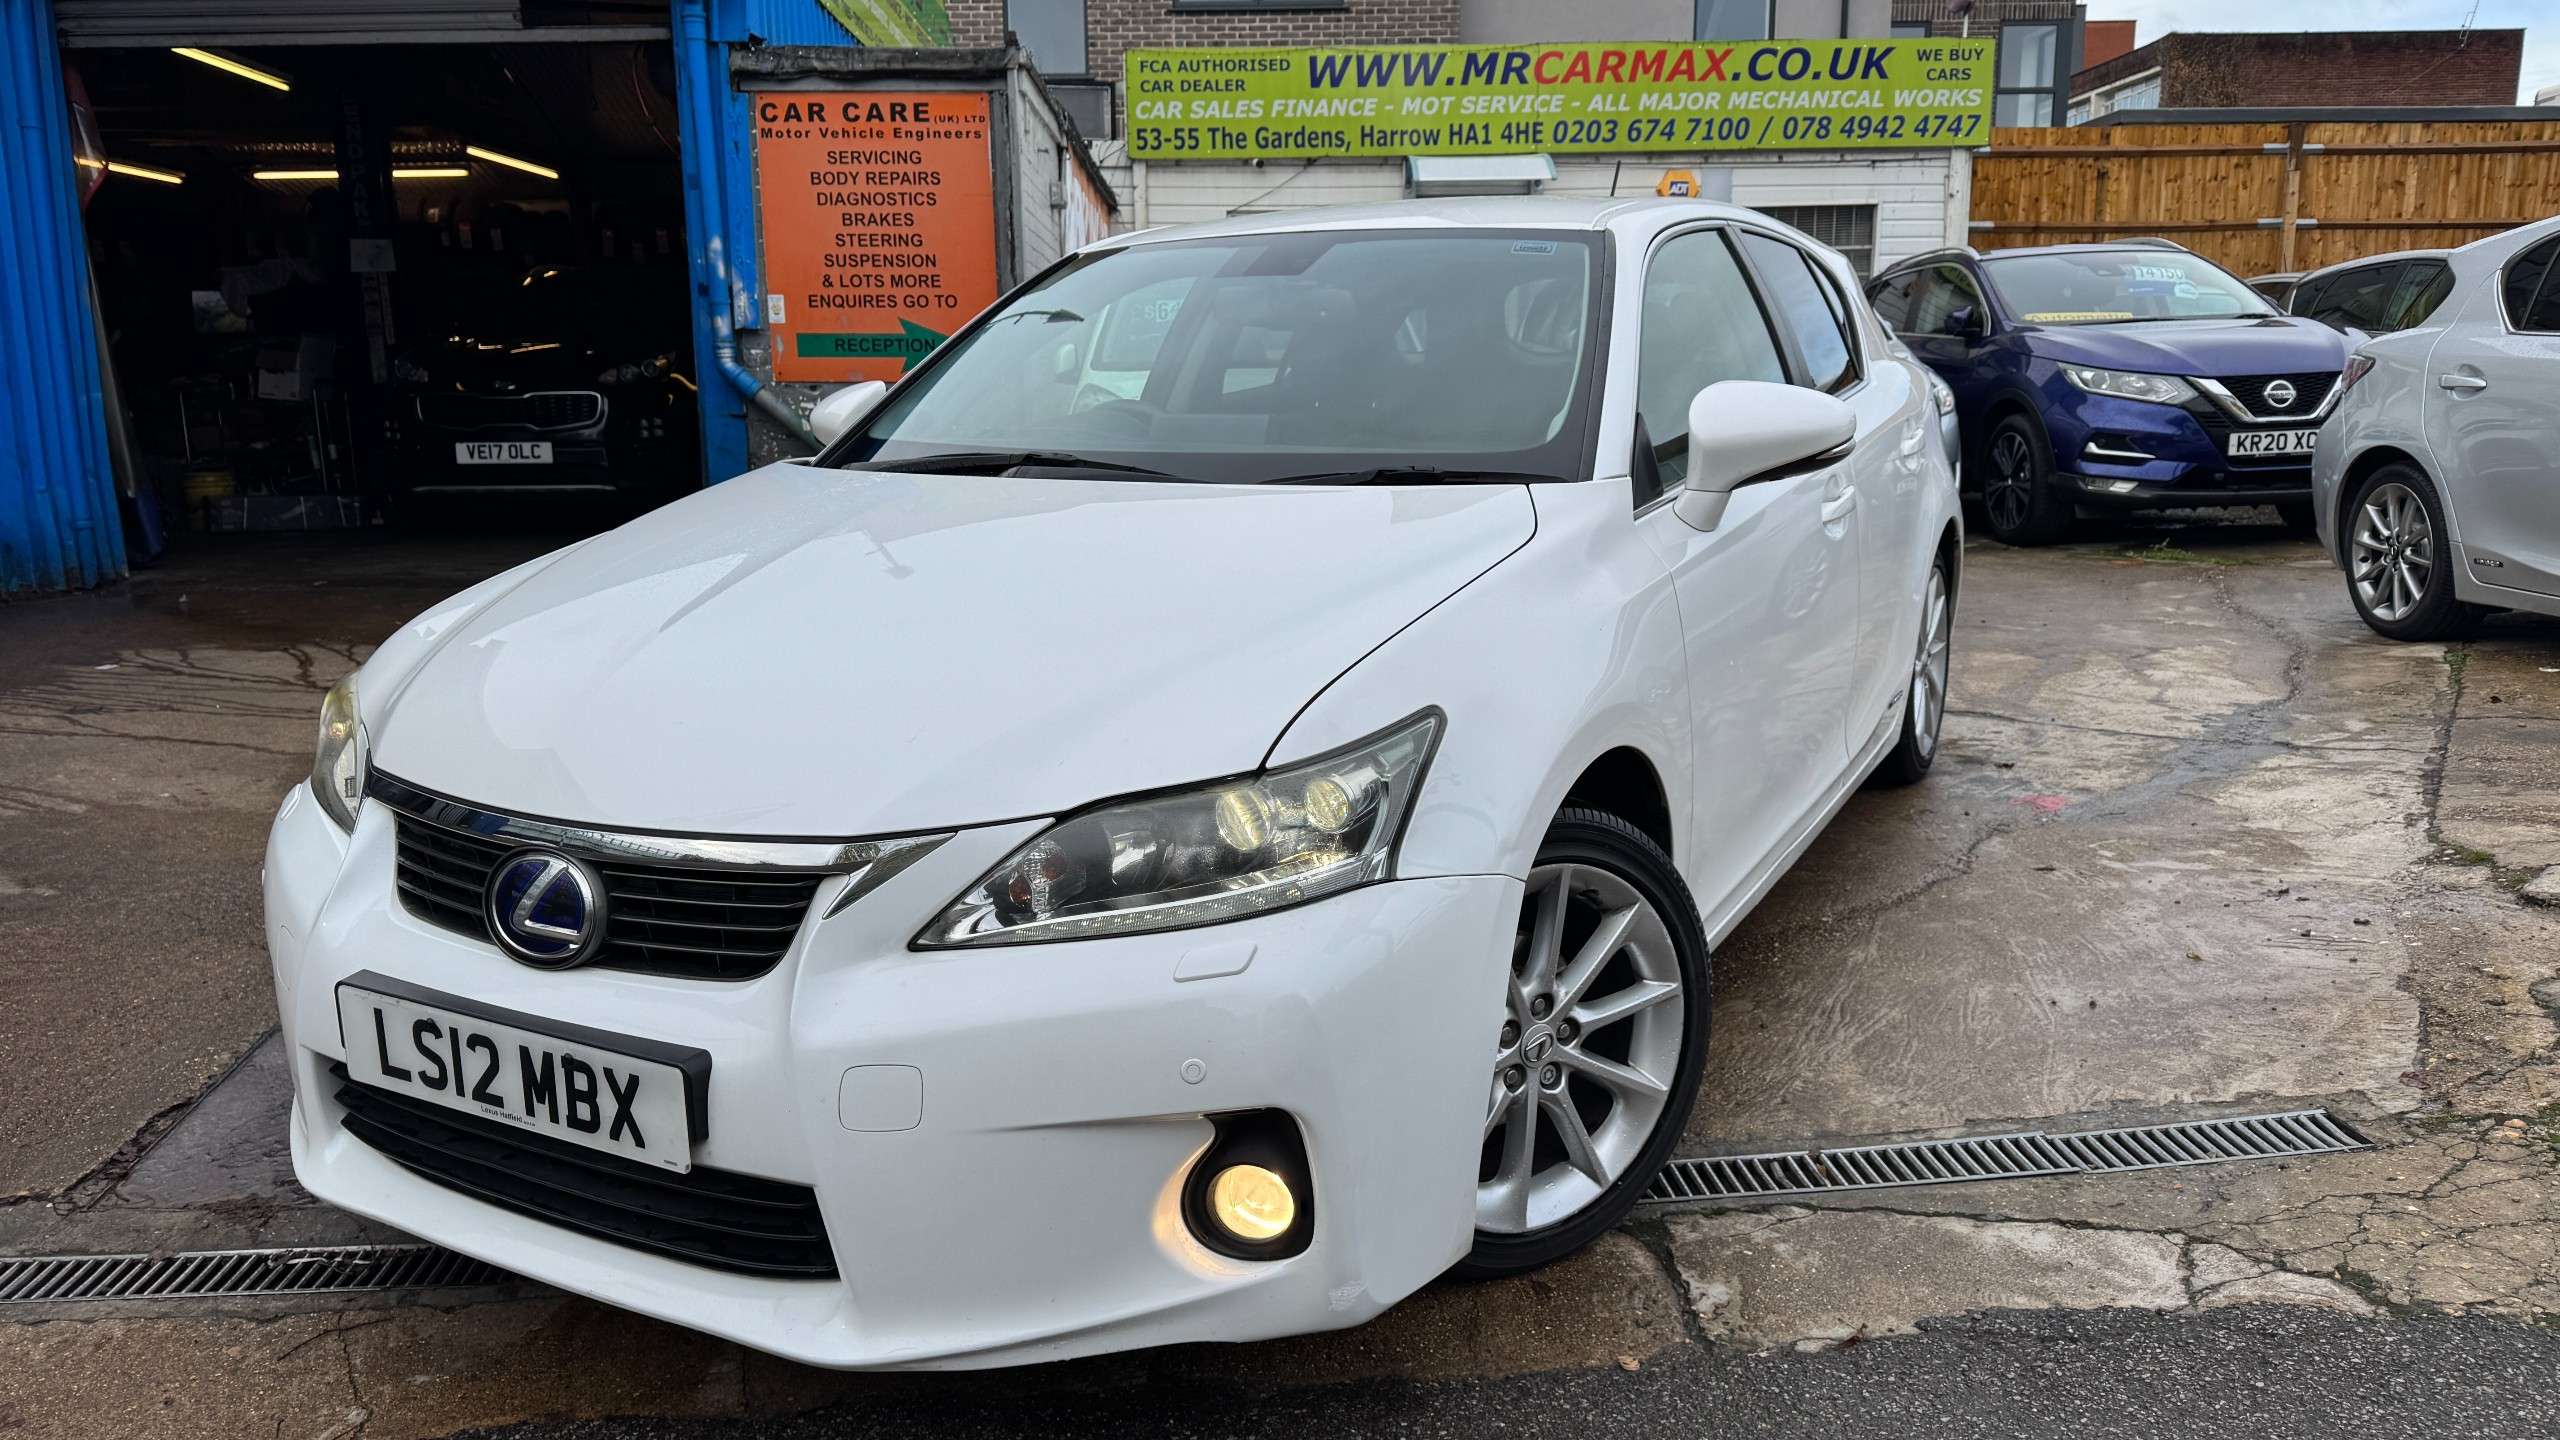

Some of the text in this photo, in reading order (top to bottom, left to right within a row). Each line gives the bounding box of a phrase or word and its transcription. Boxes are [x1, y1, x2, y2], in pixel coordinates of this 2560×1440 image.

[1917, 48, 1984, 61] WE BUY
[1139, 59, 1291, 73] FCA AUTHORISED
[1309, 46, 1897, 89] WWW.MRCARMAX.CO.UK
[1926, 68, 1972, 81] CARS
[1140, 79, 1246, 93] CAR DEALER
[1136, 101, 1183, 119] CAR
[1190, 100, 1265, 118] SALES
[1271, 98, 1378, 118] FINANCE
[1401, 96, 1455, 115] MOT
[1460, 94, 1565, 114] SERVICE
[1587, 93, 1631, 112] ALL
[1638, 91, 1721, 112] MAJOR
[1728, 89, 1884, 109] MECHANICAL
[1893, 88, 1983, 108] WORKS
[760, 102, 986, 124] CAR CARE (UK) LTD
[760, 127, 983, 141] Motor Vehicle Engineers
[1136, 114, 1982, 153] 53-55 The Gardens, Harrow HA1 4HE 0203 674 7100 / 078 4942 4747
[827, 150, 922, 165] SERVICING
[810, 171, 941, 186] BODY REPAIRS
[816, 192, 937, 206] DIAGNOSTICS
[842, 212, 915, 227] BRAKES
[835, 233, 923, 248] STEERING
[824, 254, 937, 268] SUSPENSION
[822, 274, 941, 288] & LOTS MORE
[808, 294, 958, 309] ENQUIRES GO TO
[834, 338, 936, 353] RECEPTION
[2236, 432, 2289, 453] KR20
[466, 444, 503, 460] VE17
[373, 1007, 646, 1150] LS12 MBX
